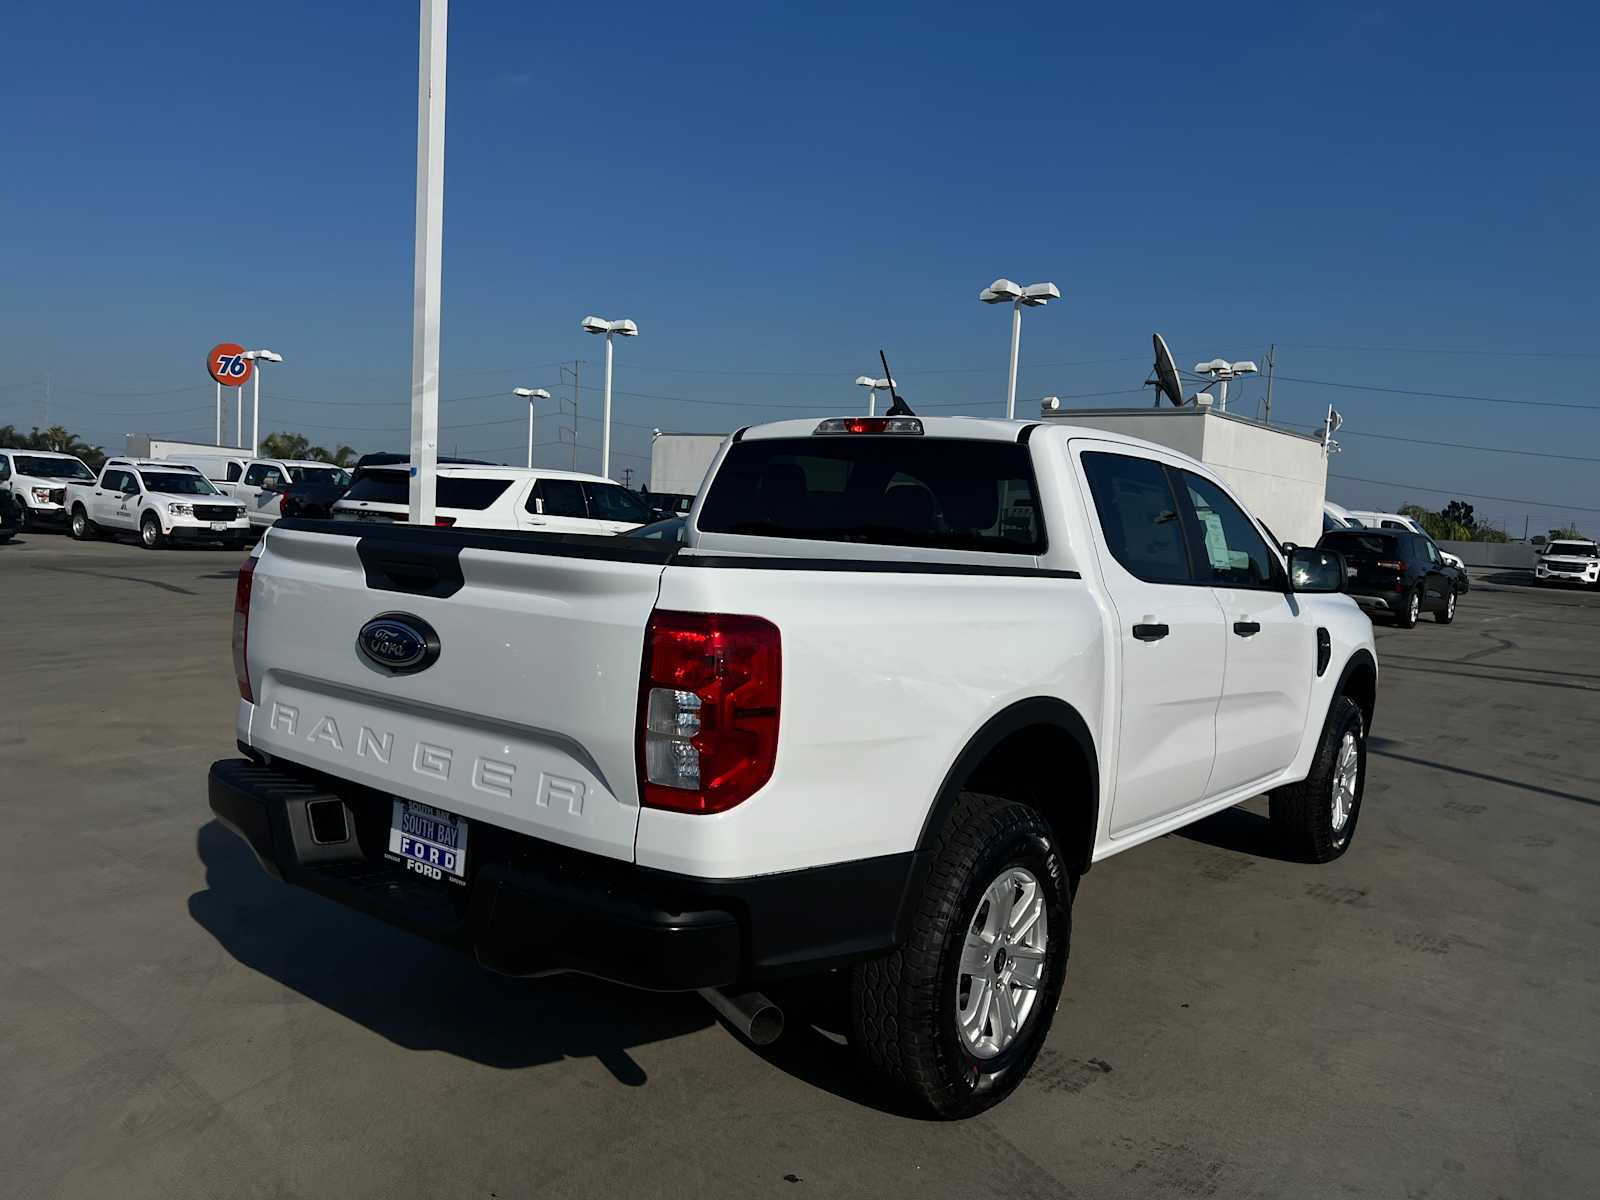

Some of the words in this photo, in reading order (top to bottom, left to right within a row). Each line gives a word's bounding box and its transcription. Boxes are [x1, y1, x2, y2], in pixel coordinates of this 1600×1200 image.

[217, 354, 246, 377] 76
[370, 628, 408, 656] Ford
[270, 702, 587, 816] RANGER
[403, 814, 434, 838] SOUTH
[437, 824, 457, 846] BAY
[402, 838, 454, 869] FORD
[407, 859, 441, 880] FORD
